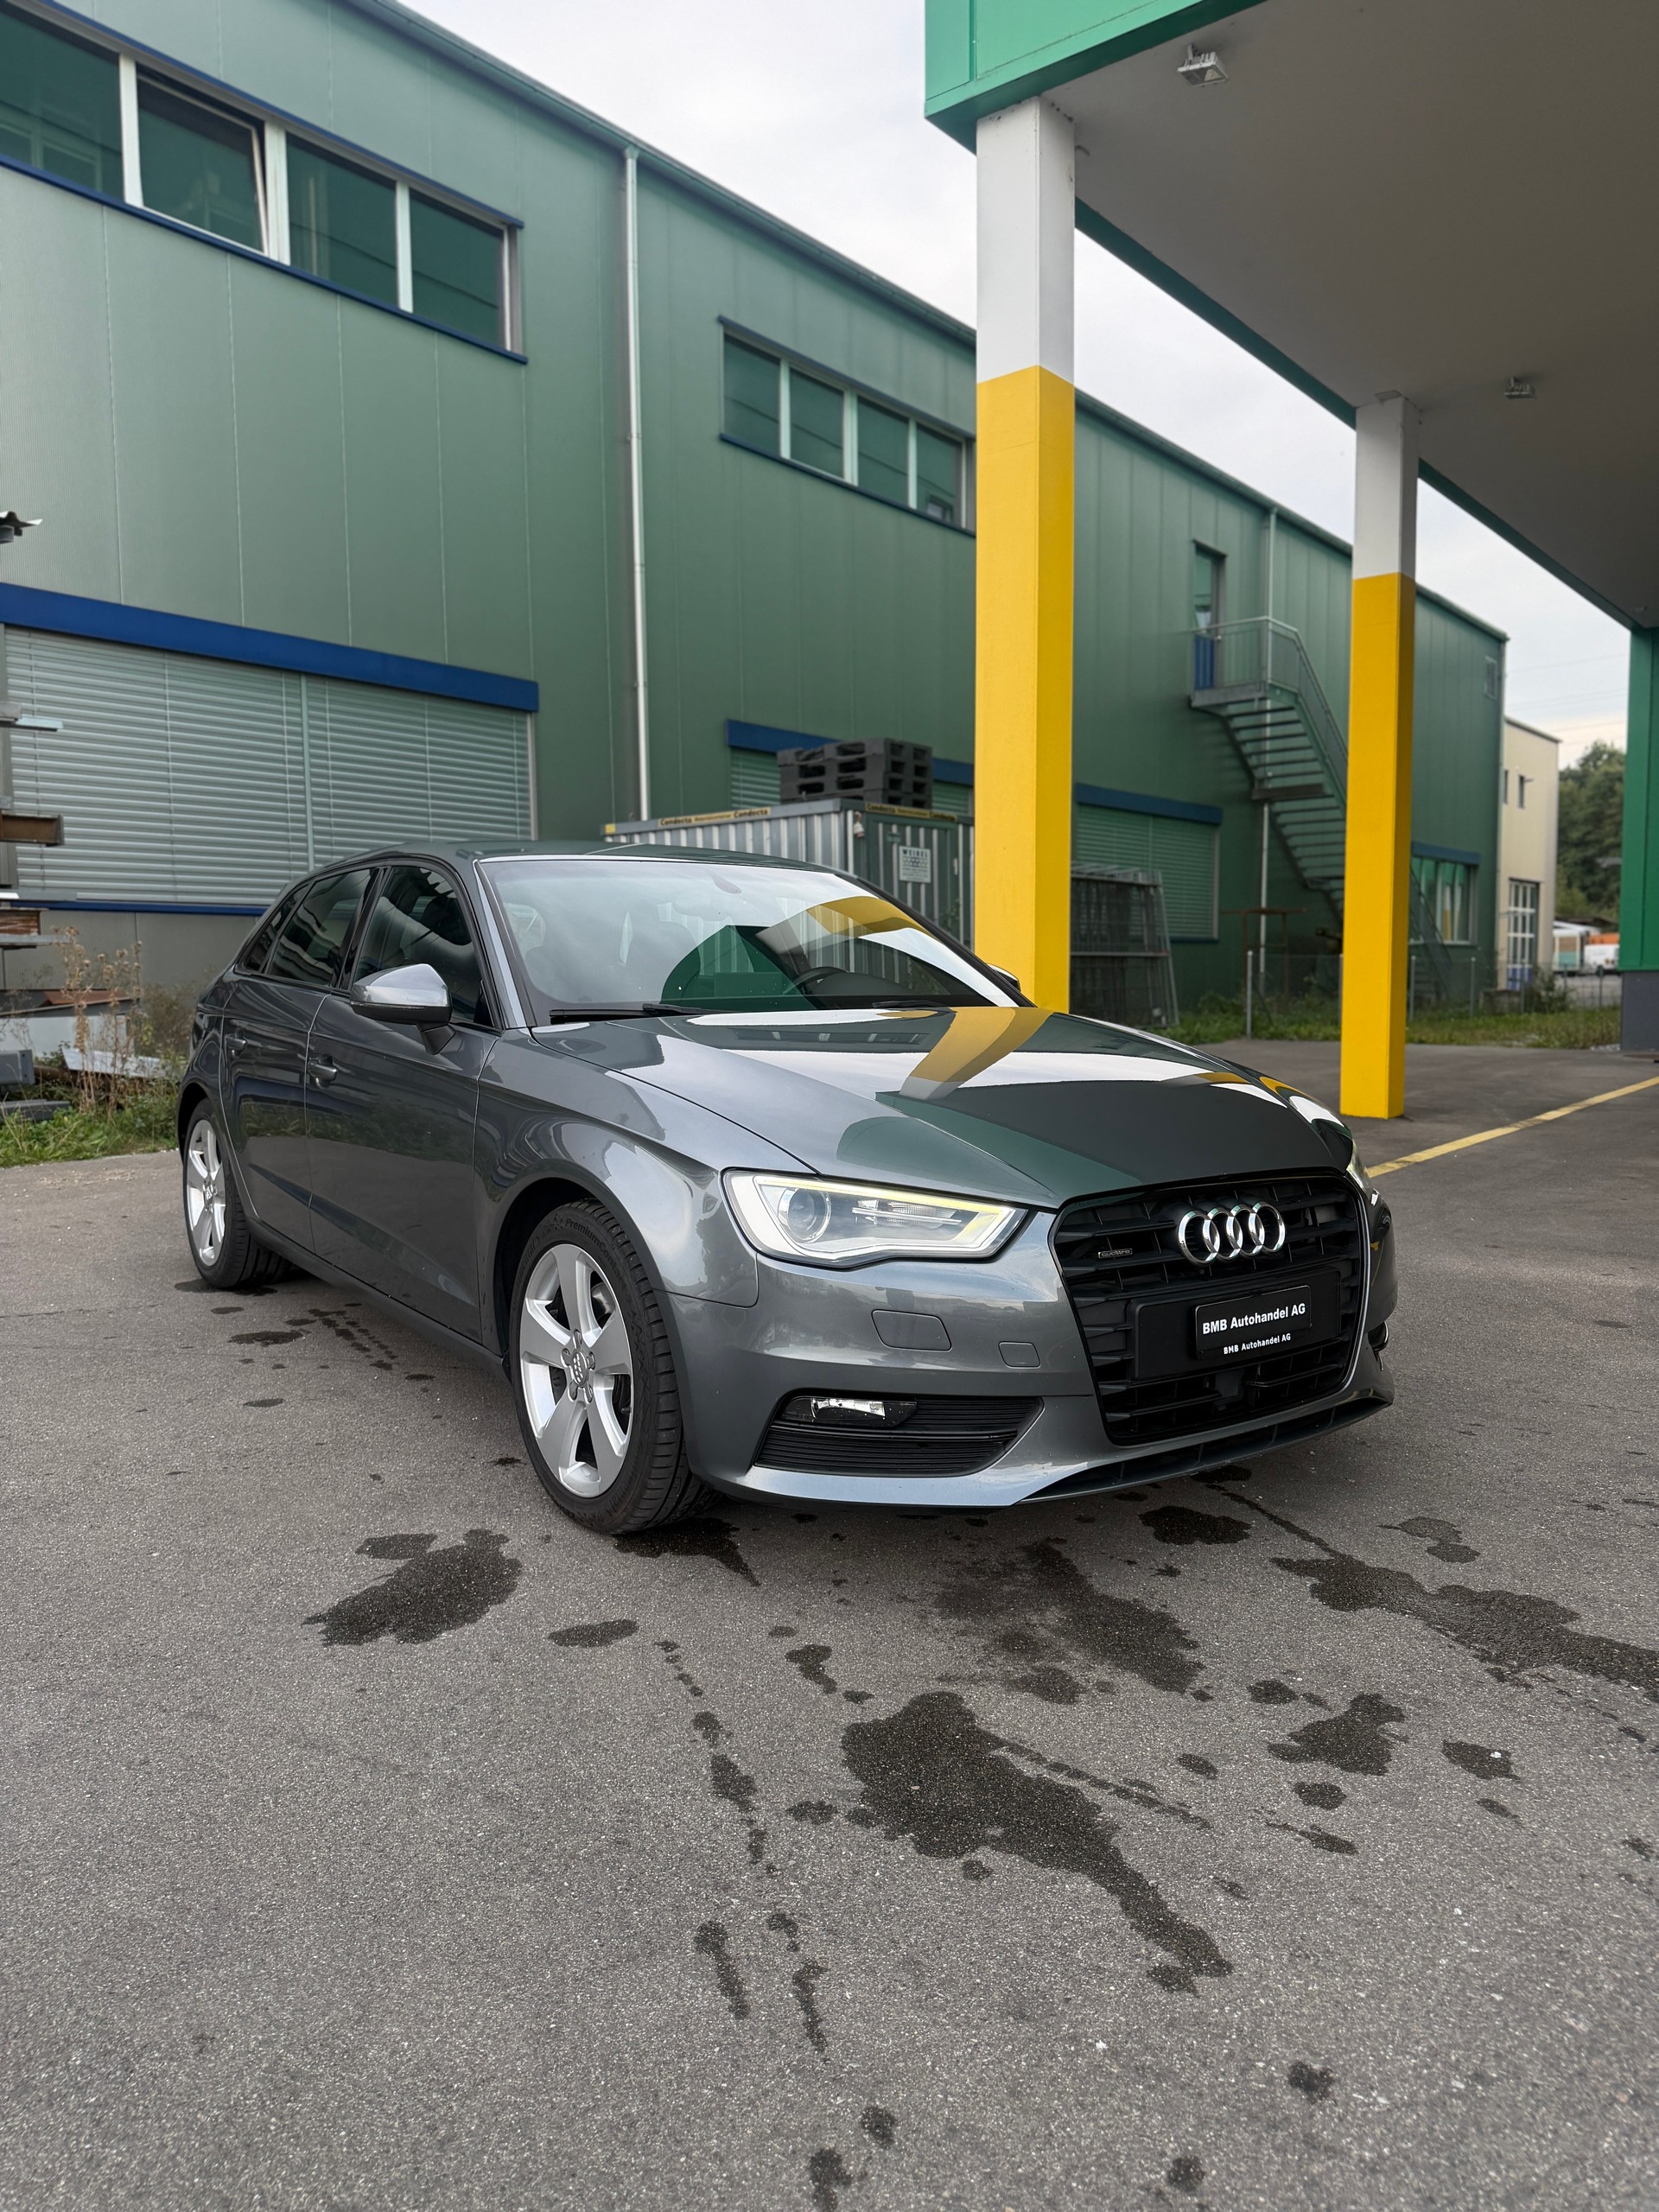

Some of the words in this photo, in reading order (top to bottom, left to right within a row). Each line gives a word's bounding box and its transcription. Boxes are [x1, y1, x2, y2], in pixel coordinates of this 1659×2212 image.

[1203, 1319, 1227, 1334] BMB
[1230, 1306, 1288, 1329] Autohandel
[1291, 1303, 1306, 1316] AG
[1224, 1344, 1239, 1355] BMB
[1242, 1335, 1280, 1351] Autohandel
[1281, 1332, 1291, 1342] AG
